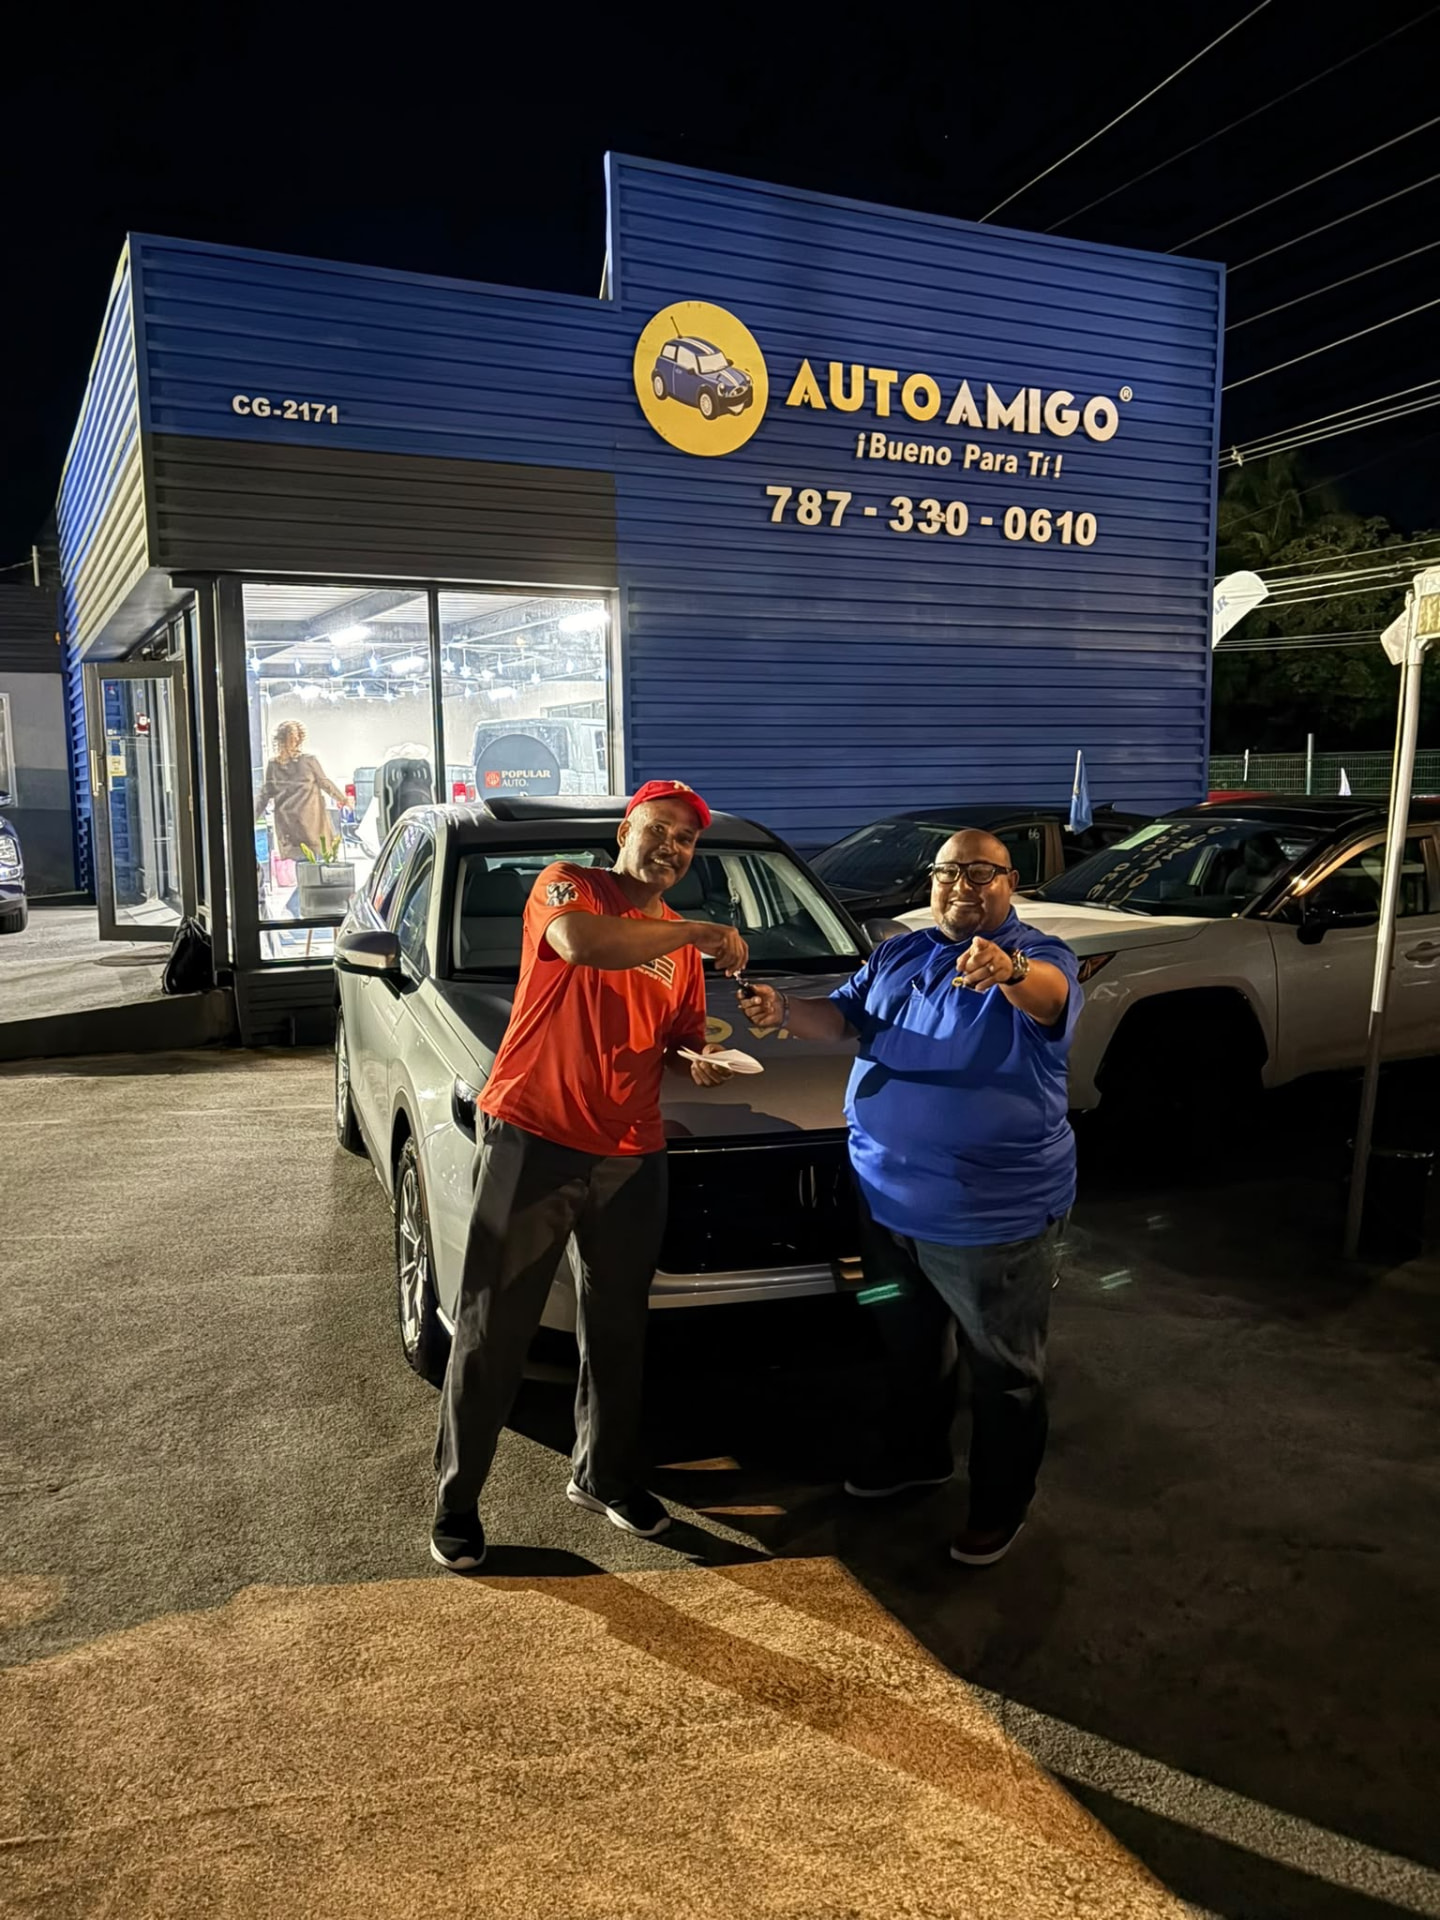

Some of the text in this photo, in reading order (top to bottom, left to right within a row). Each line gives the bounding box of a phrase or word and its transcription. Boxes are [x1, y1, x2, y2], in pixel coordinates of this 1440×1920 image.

[856, 432, 952, 466] ¡Bueno
[963, 444, 1018, 473] Para
[501, 769, 552, 779] POPULAR
